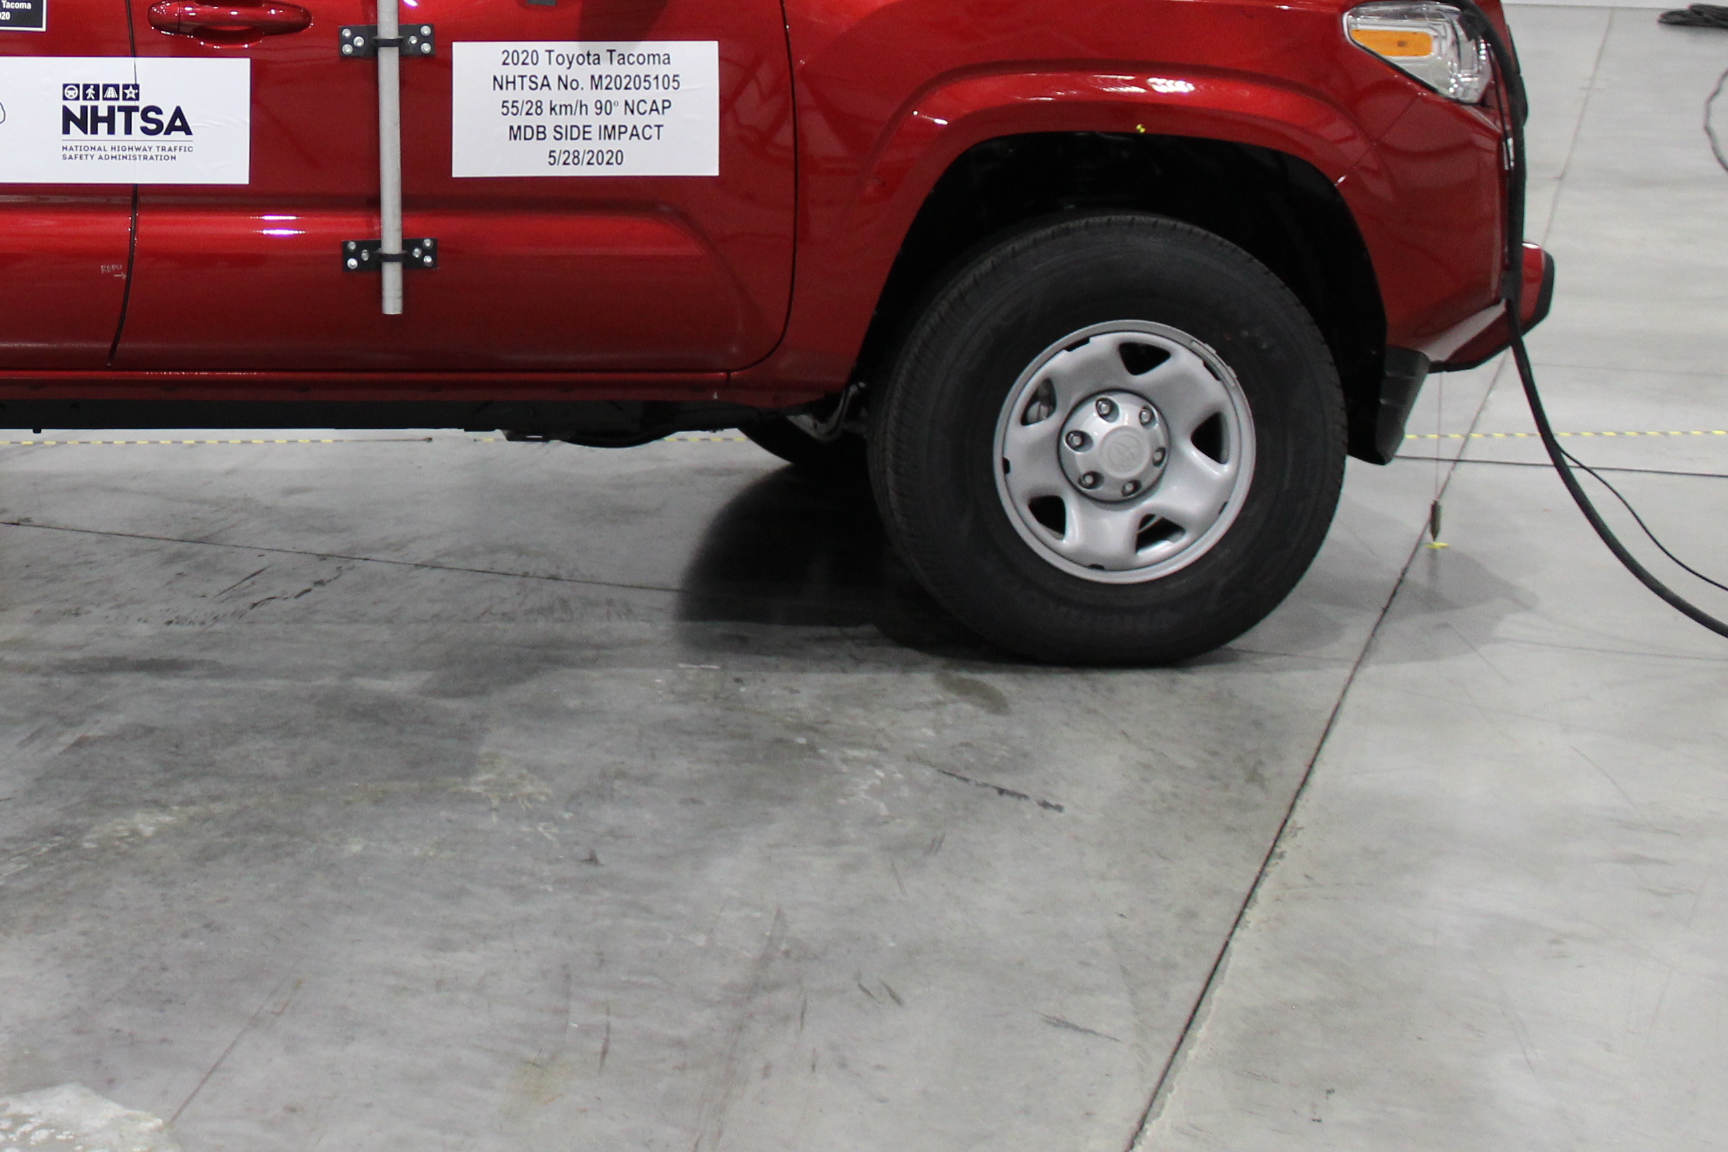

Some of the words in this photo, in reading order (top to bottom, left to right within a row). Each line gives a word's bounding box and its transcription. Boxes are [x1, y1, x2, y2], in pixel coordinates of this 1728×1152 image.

[1, 0, 32, 10] Tacoma
[501, 49, 540, 66] 2020
[544, 49, 601, 70] Toyota
[605, 49, 672, 66] Tacoma
[492, 74, 552, 91] NHTSA
[557, 74, 584, 91] No.
[590, 74, 681, 91] M20205105
[500, 99, 544, 116] 55/28
[549, 99, 589, 116] km/h
[624, 99, 672, 116] NCAP
[62, 104, 193, 137] NHTSA
[508, 124, 547, 141] MDB
[552, 124, 593, 141] SIDE
[598, 124, 664, 141] IMPACT
[62, 153, 95, 161] SAFETY
[97, 154, 177, 162] ADMINISTRATION
[547, 149, 624, 166] 5/28/2020
